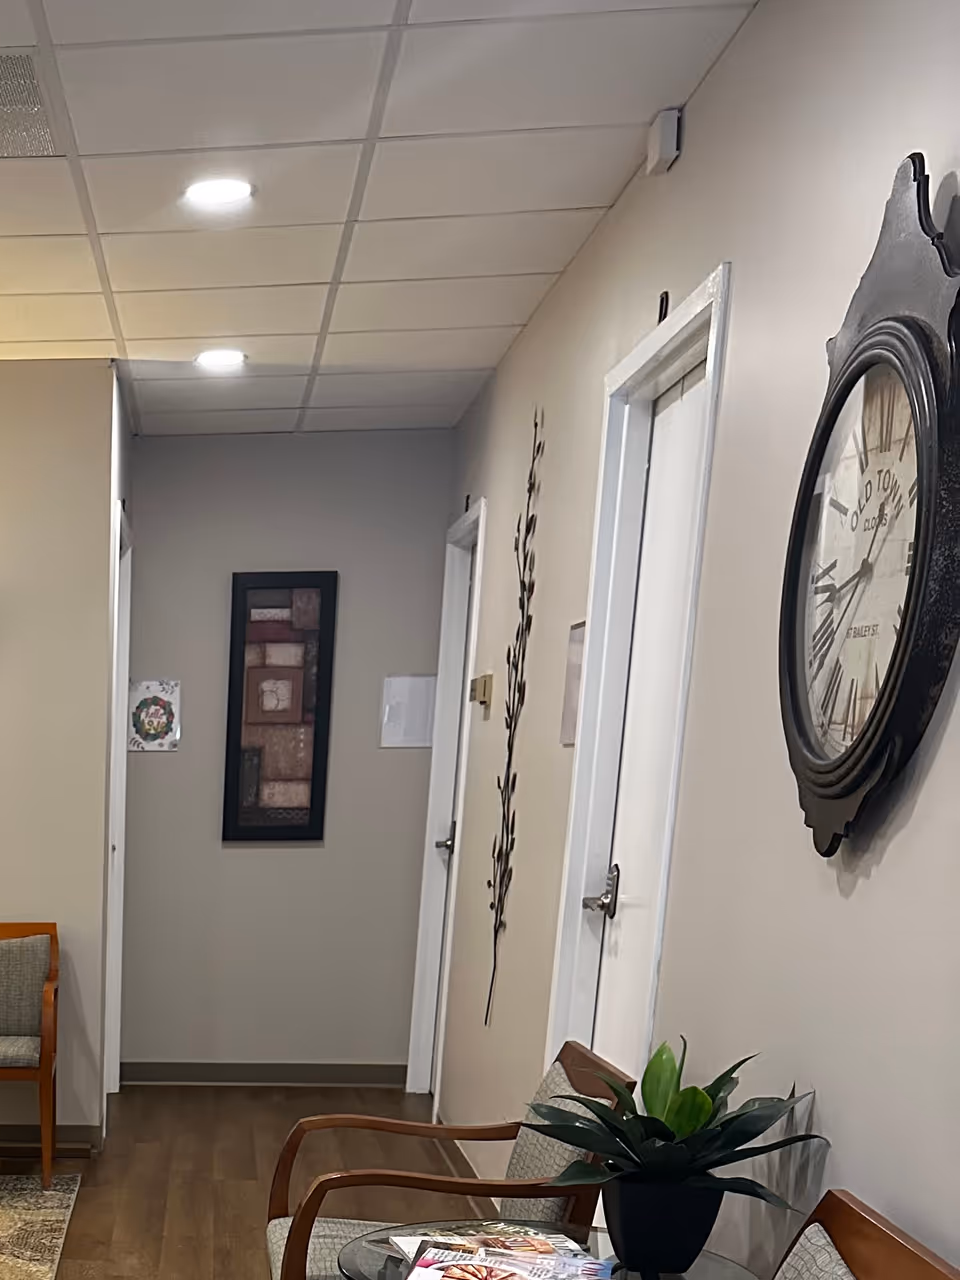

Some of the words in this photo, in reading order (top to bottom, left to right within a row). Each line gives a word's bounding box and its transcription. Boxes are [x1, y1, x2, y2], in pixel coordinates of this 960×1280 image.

[851, 479, 872, 532] OLD
[877, 469, 903, 520] TOWN
[864, 513, 888, 532] CLOS
